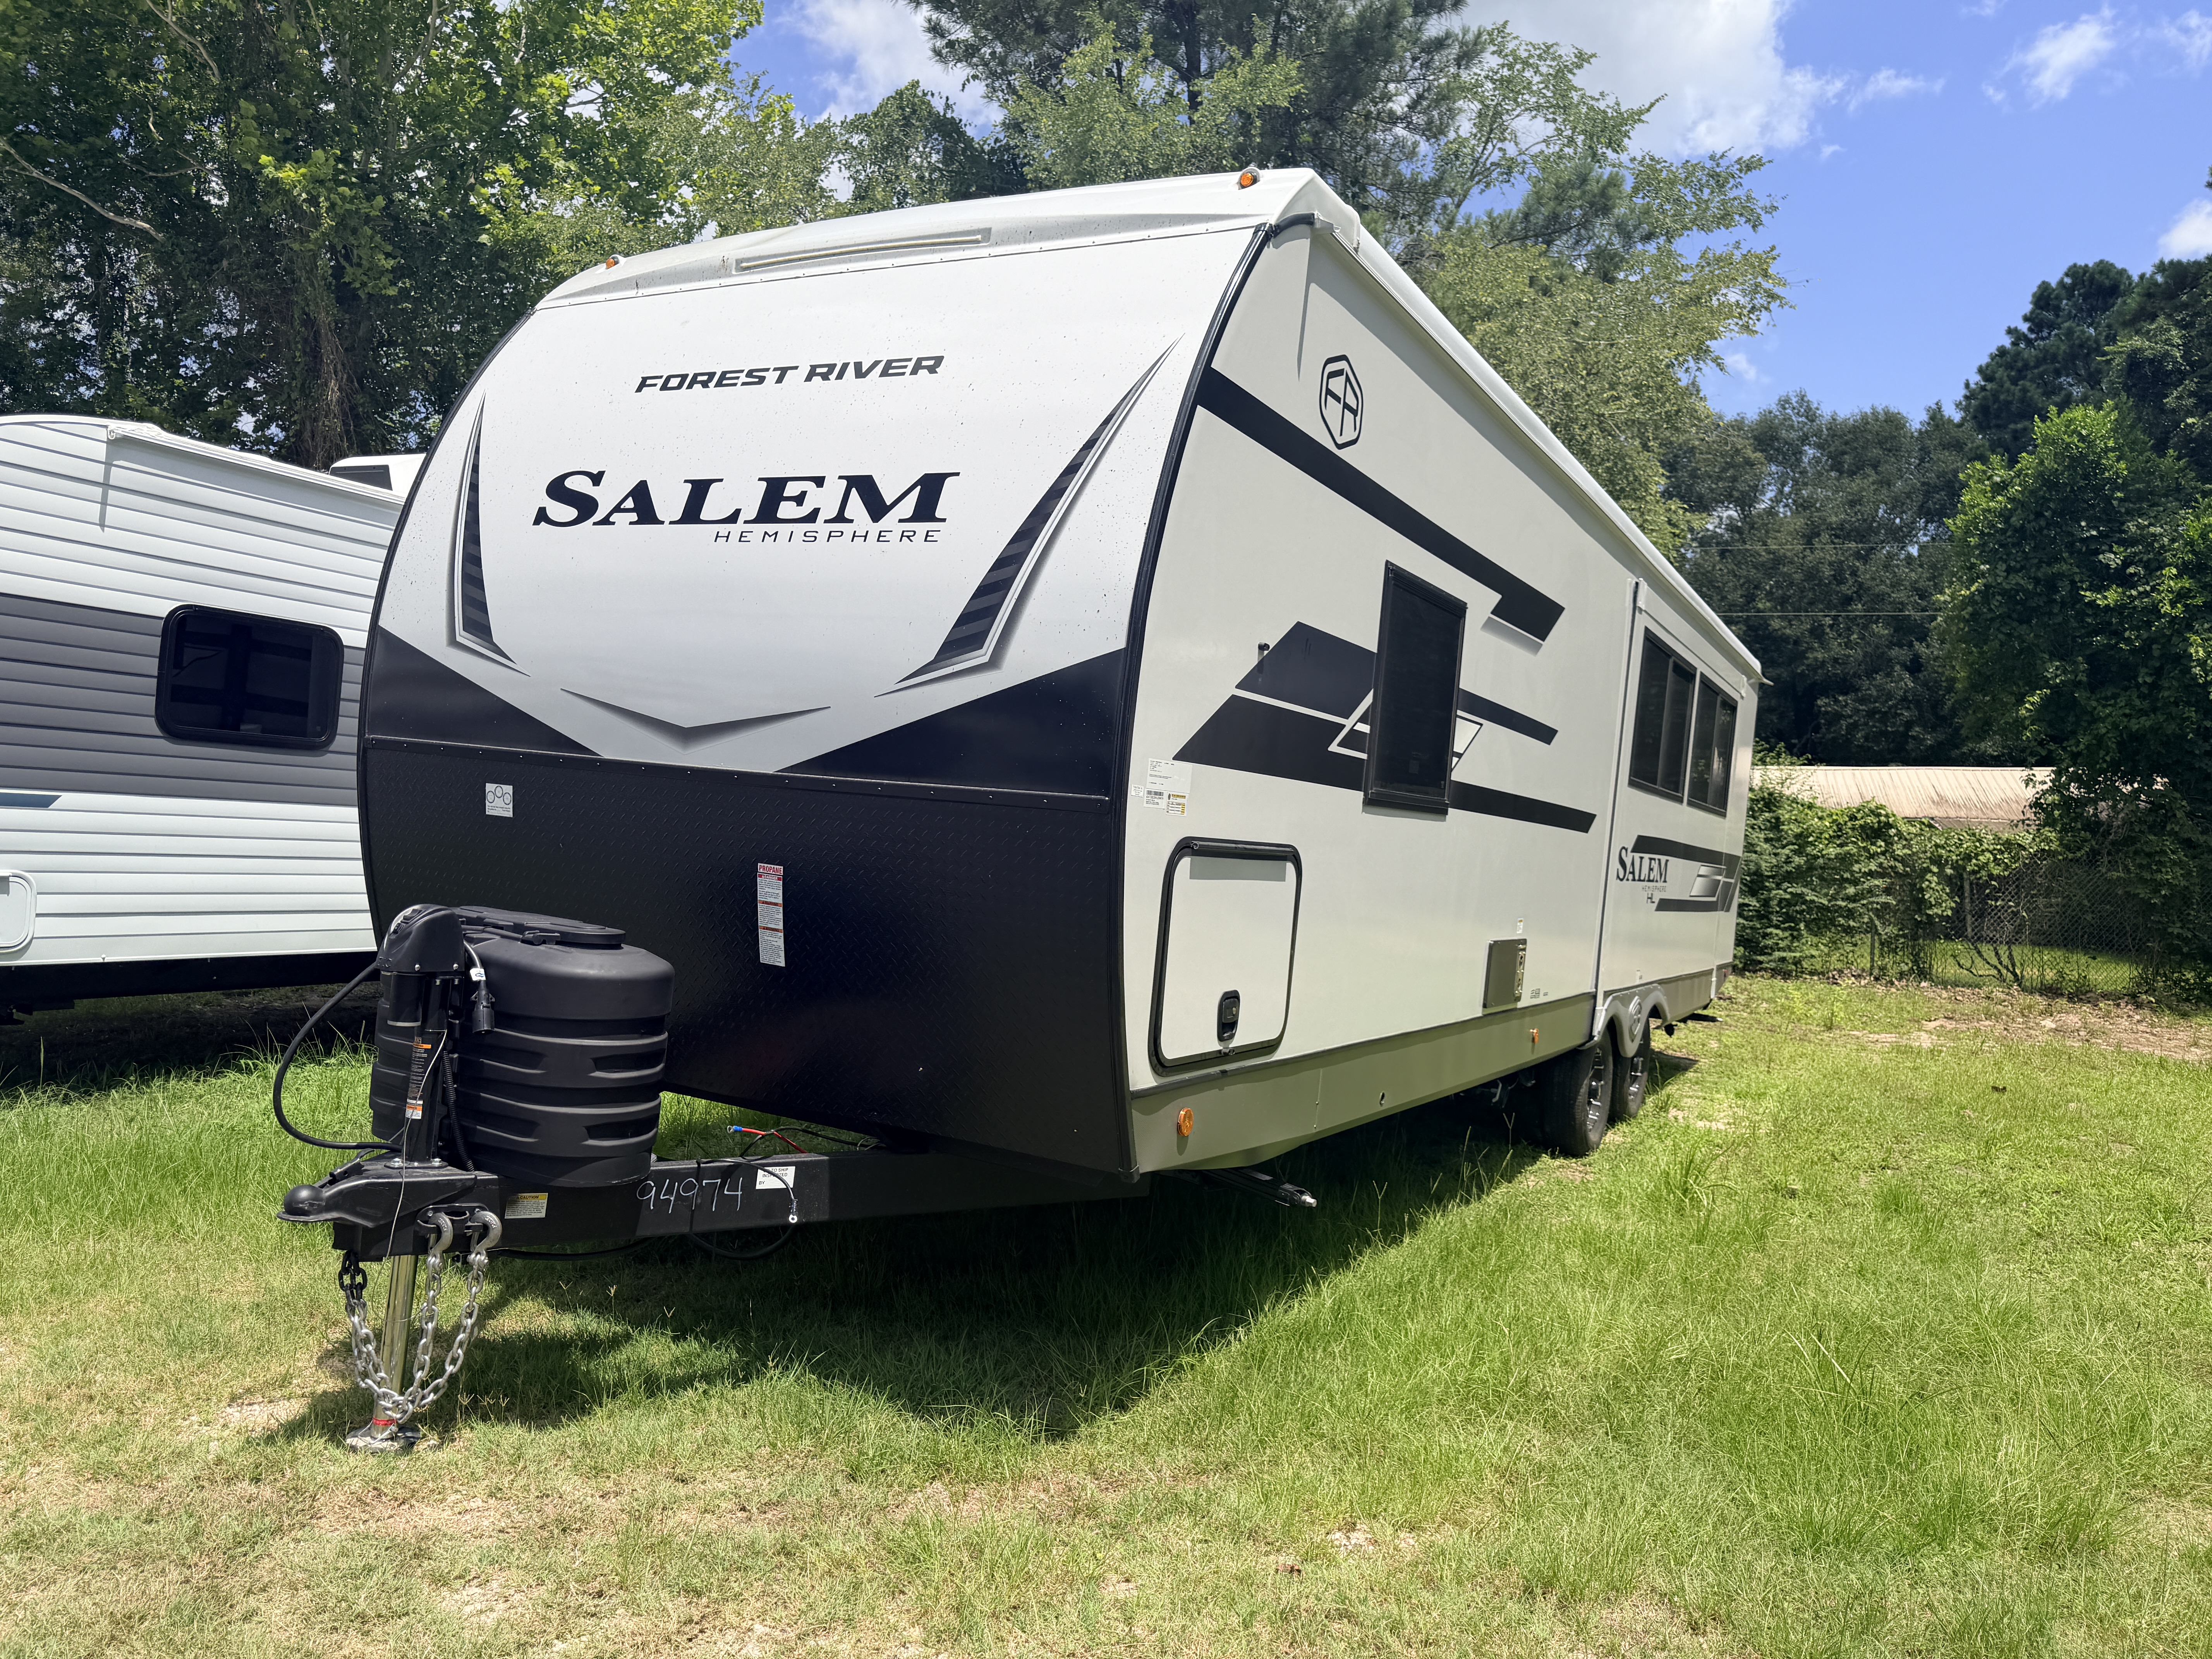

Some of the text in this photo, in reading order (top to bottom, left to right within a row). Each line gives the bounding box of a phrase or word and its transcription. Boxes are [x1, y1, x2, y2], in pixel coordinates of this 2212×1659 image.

[634, 355, 945, 393] FOREST RIVER
[532, 470, 960, 527] SALEM
[714, 530, 941, 543] HEMISPHERE
[759, 865, 782, 874] PROPANE
[1616, 846, 1669, 883] SALEM
[636, 1177, 742, 1214] 94974
